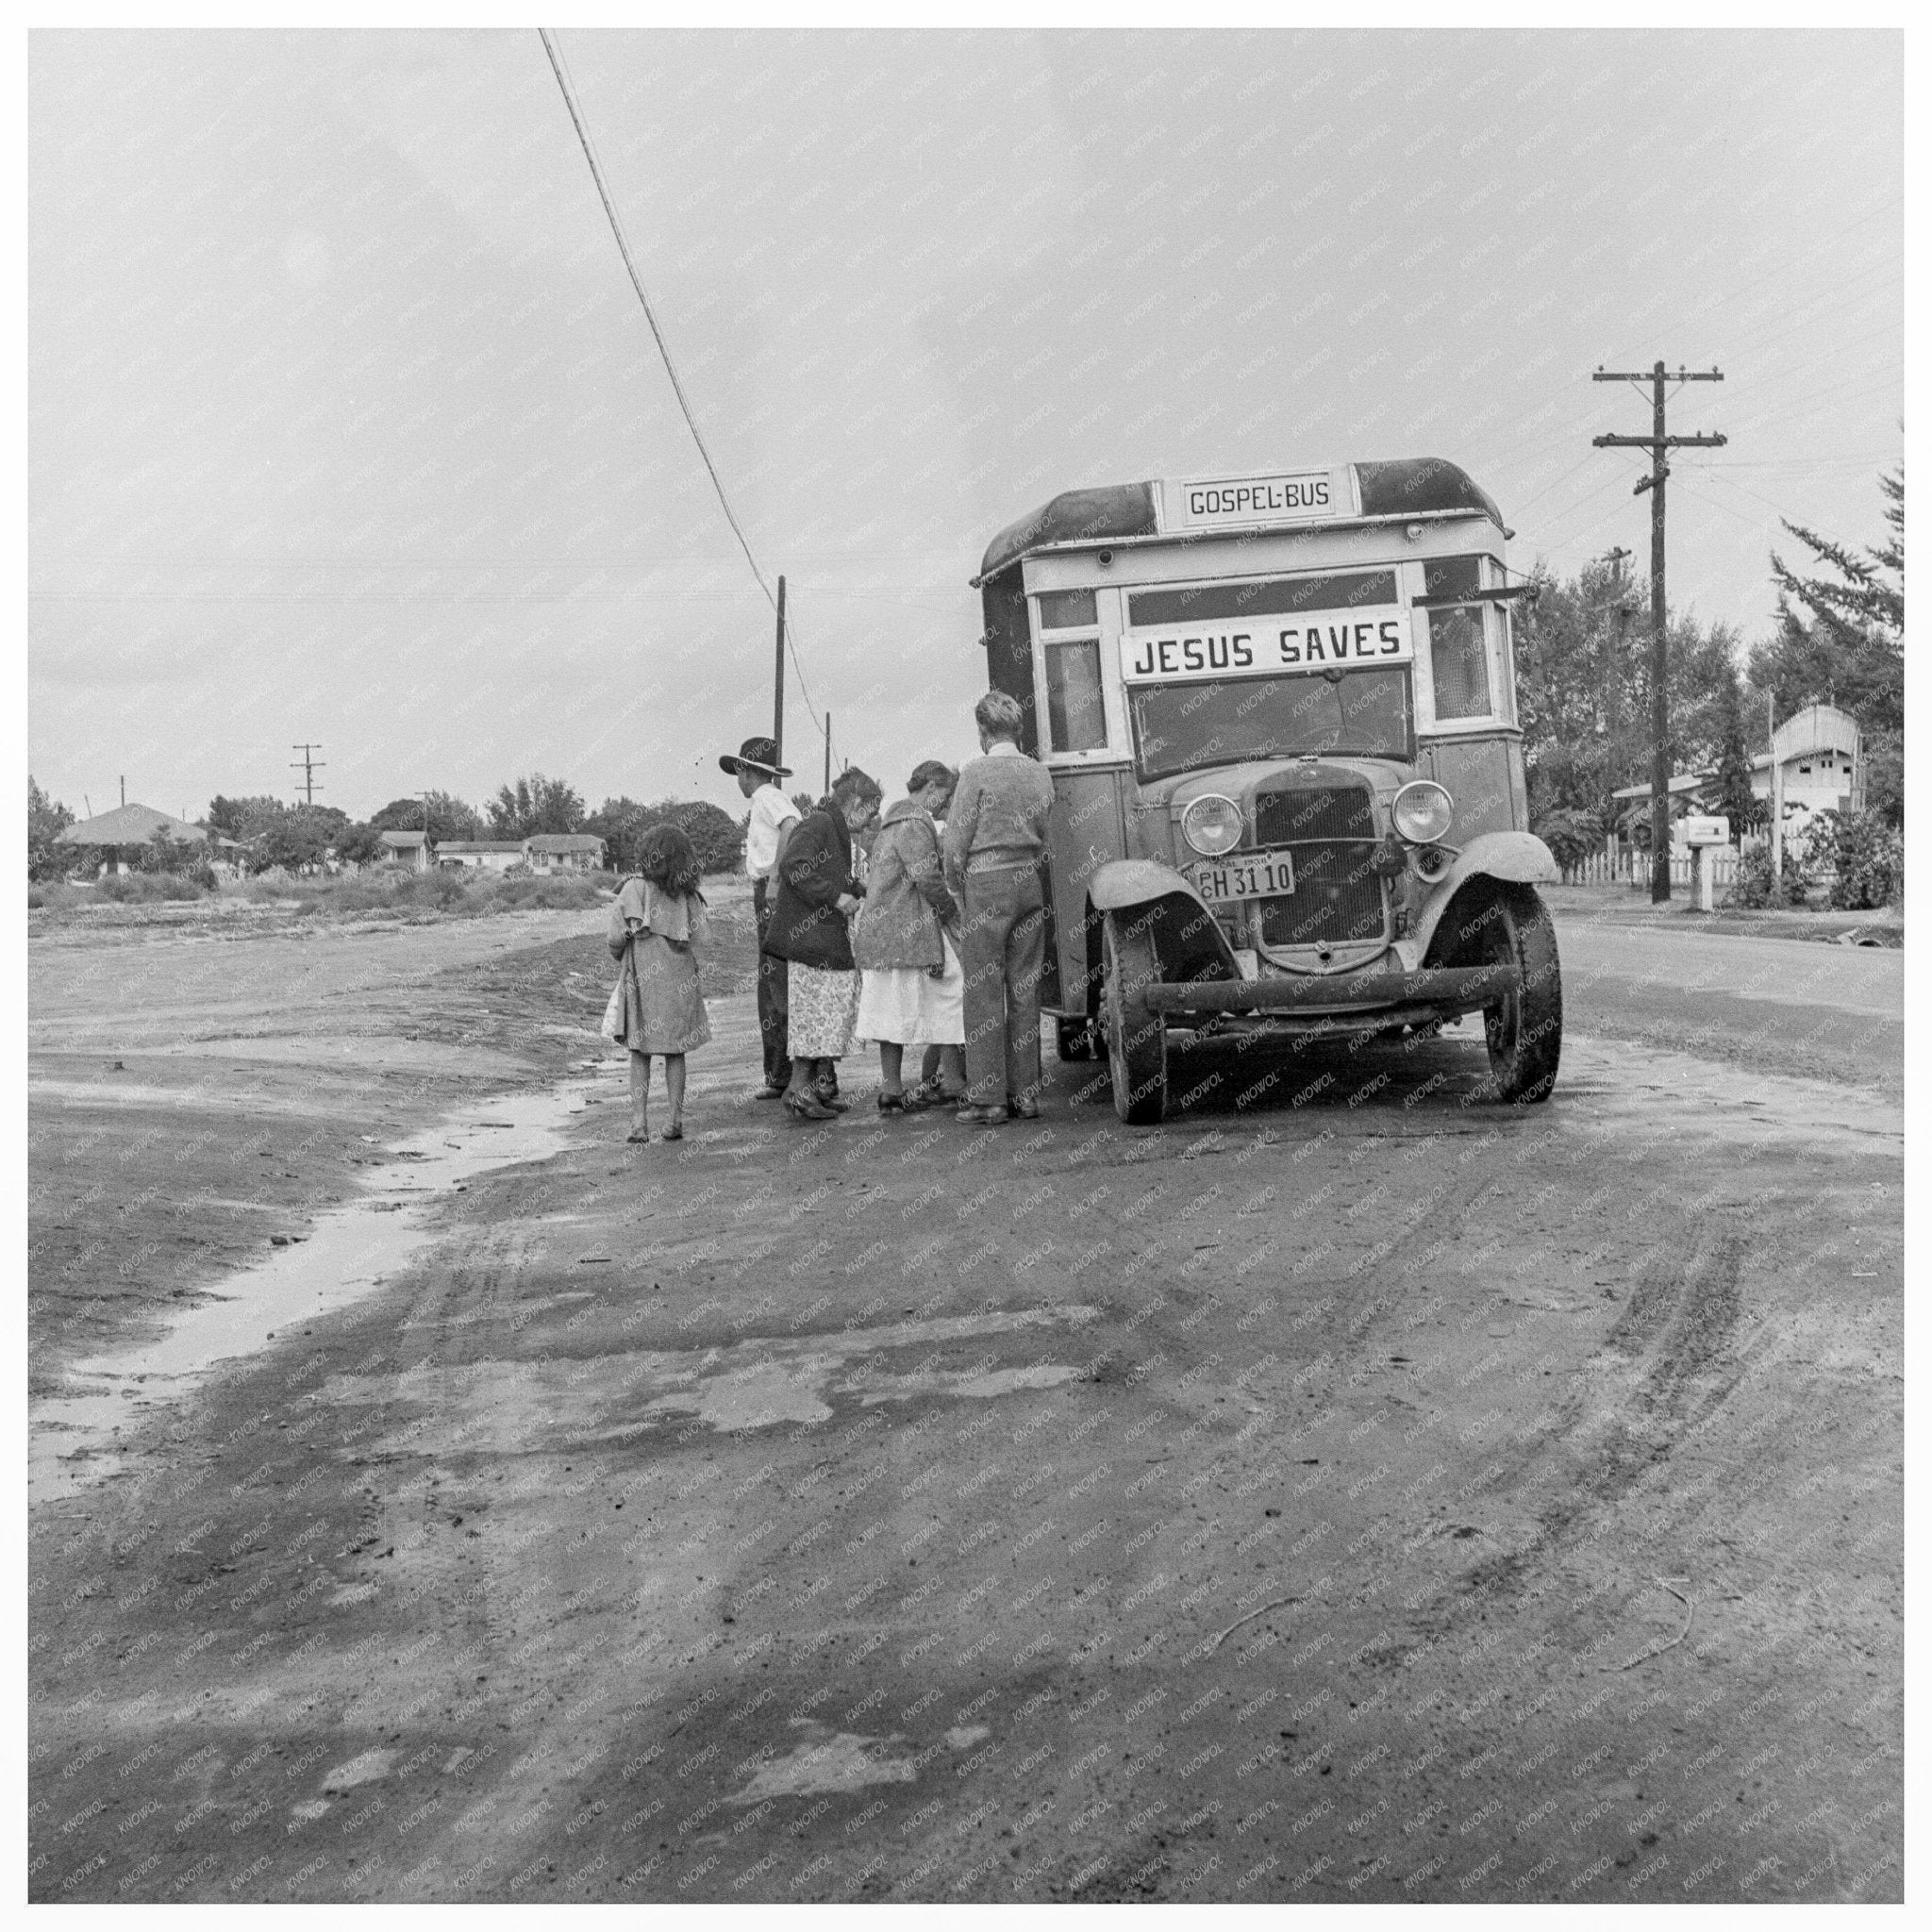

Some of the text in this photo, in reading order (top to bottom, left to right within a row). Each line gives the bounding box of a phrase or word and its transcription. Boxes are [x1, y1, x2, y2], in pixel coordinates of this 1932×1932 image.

[1191, 482, 1329, 515] GOSPEL-BUS
[1135, 621, 1400, 675] JESUS SAVES
